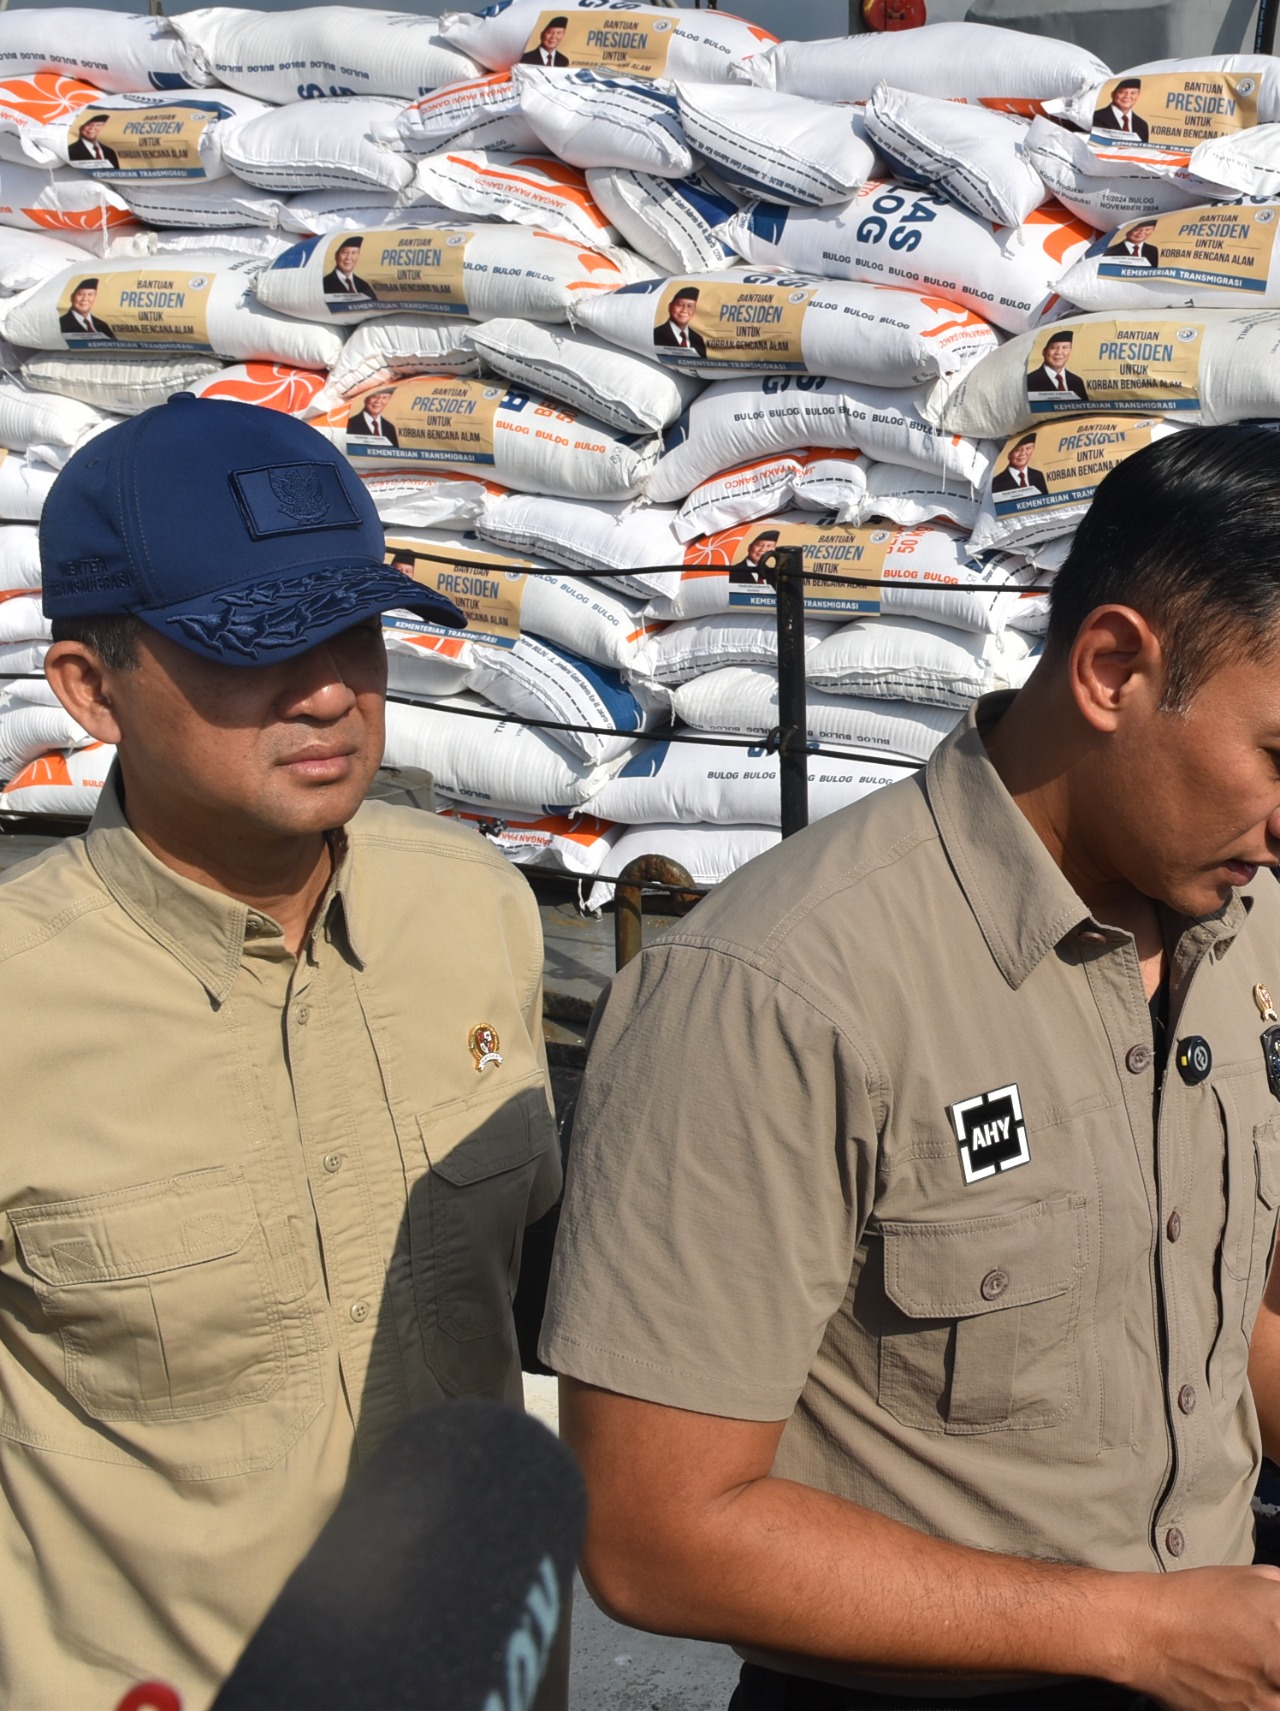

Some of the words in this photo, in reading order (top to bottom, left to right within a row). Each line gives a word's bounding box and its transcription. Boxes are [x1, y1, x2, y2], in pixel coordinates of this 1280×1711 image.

[603, 20, 638, 30] BANTUAN
[586, 31, 648, 49] PRESIDEN
[703, 38, 732, 54] BULOG
[602, 50, 627, 61] UNTUK
[1184, 82, 1223, 94] BANTUAN
[1165, 93, 1236, 117] PRESIDEN
[143, 114, 176, 122] BANTUAN
[1184, 116, 1211, 127] UNTUK
[123, 121, 183, 135] PRESIDEN
[138, 138, 161, 147] UNTUK
[1040, 170, 1055, 183] Kode
[1056, 180, 1084, 194] Produksi
[1102, 195, 1126, 203] 11/2024
[1100, 203, 1141, 211] NOVEMBER
[1199, 215, 1238, 223] BANTUAN
[1178, 224, 1250, 239] PRESIDEN
[398, 238, 432, 247] BANTUAN
[1196, 239, 1224, 249] UNTUK
[381, 249, 441, 267] PRESIDEN
[822, 252, 851, 264] BULOG
[855, 258, 884, 271] BULOG
[1160, 249, 1192, 260] KORBAN
[1193, 251, 1229, 263] BENCANA
[1230, 254, 1254, 266] ALAM
[397, 270, 421, 280] UNTUK
[493, 266, 522, 275] BULOG
[526, 270, 555, 281] BULOG
[1121, 268, 1176, 278] KEMENTERIAN
[1179, 270, 1242, 287] TRANSMIGRASI
[136, 280, 174, 290] BANTUAN
[120, 291, 185, 308] PRESIDEN
[737, 294, 773, 303] BANTUAN
[138, 311, 163, 322] UNTUK
[719, 304, 783, 324] PRESIDEN
[843, 306, 875, 321] BULOG
[735, 326, 761, 337] UNTUK
[1116, 331, 1159, 340] BANTUAN
[769, 341, 789, 351] ALAM
[1099, 343, 1173, 362] PRESIDEN
[1119, 364, 1149, 375] UNTUK
[1087, 379, 1119, 390] KORBAN
[1120, 379, 1159, 389] BENCANA
[431, 388, 467, 397] BANTUAN
[411, 397, 476, 415] PRESIDEN
[427, 415, 451, 427] UNTUK
[734, 411, 765, 421] BULOG
[769, 408, 799, 418] BULOG
[495, 420, 530, 435] BULOG
[535, 429, 569, 446] BULOG
[1077, 424, 1117, 432] BANTUAN
[399, 427, 425, 439] KORBAN
[426, 428, 461, 441] BENCANA
[460, 431, 481, 443] ALAM
[1058, 432, 1126, 452] PRESIDEN
[367, 448, 418, 458] KEMENTERIAN
[422, 451, 475, 461] TRANSMIGRASI
[1076, 448, 1105, 462] UNTUK
[1046, 467, 1077, 482] KORBAN
[1079, 461, 1113, 478] BENCANA
[1016, 493, 1070, 510] KEMENTERIAN
[818, 535, 855, 543] BANTUAN
[802, 545, 864, 560] PRESIDEN
[813, 562, 839, 573] UNTUK
[883, 569, 918, 579] BULOG
[924, 572, 958, 584] BULOG
[437, 573, 500, 599] PRESIDEN
[455, 596, 480, 610] UNTUK
[560, 583, 590, 604] BULOG
[592, 603, 620, 626] BULOG
[395, 621, 445, 635] KEMENTERIAN
[448, 629, 498, 644] TRANSMIGRASI
[707, 771, 739, 779] BULOG
[743, 771, 776, 780] BULOG
[819, 775, 853, 783] BULOG
[972, 1117, 1011, 1152] AHY
